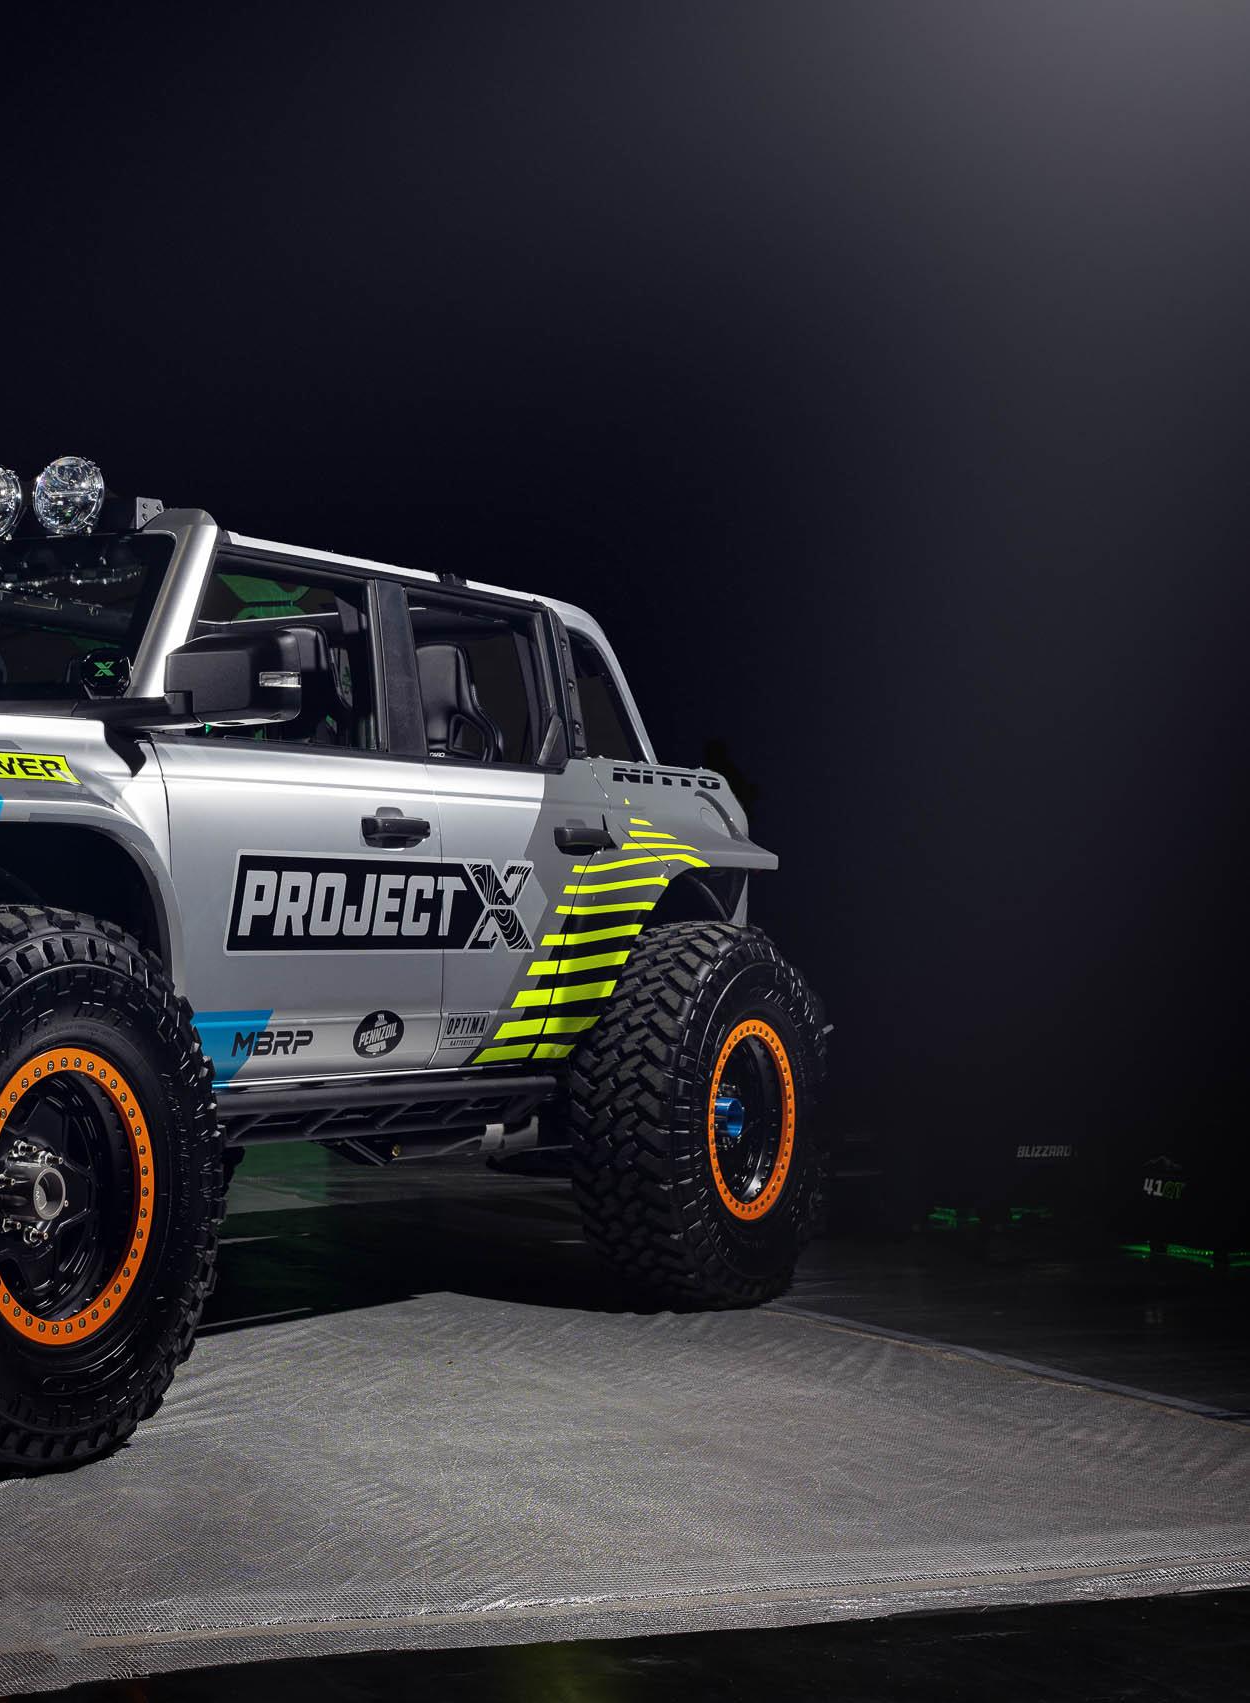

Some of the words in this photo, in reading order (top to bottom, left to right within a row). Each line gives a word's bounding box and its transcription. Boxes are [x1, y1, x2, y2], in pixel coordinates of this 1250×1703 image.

[613, 767, 721, 790] NITTO
[237, 869, 468, 937] PROJECT
[463, 858, 535, 953] X
[358, 1022, 398, 1048] PENNZOIL
[446, 1015, 487, 1036] OPTIMA
[231, 1029, 314, 1057] MBRP
[1016, 1145, 1073, 1159] BLIZZARD
